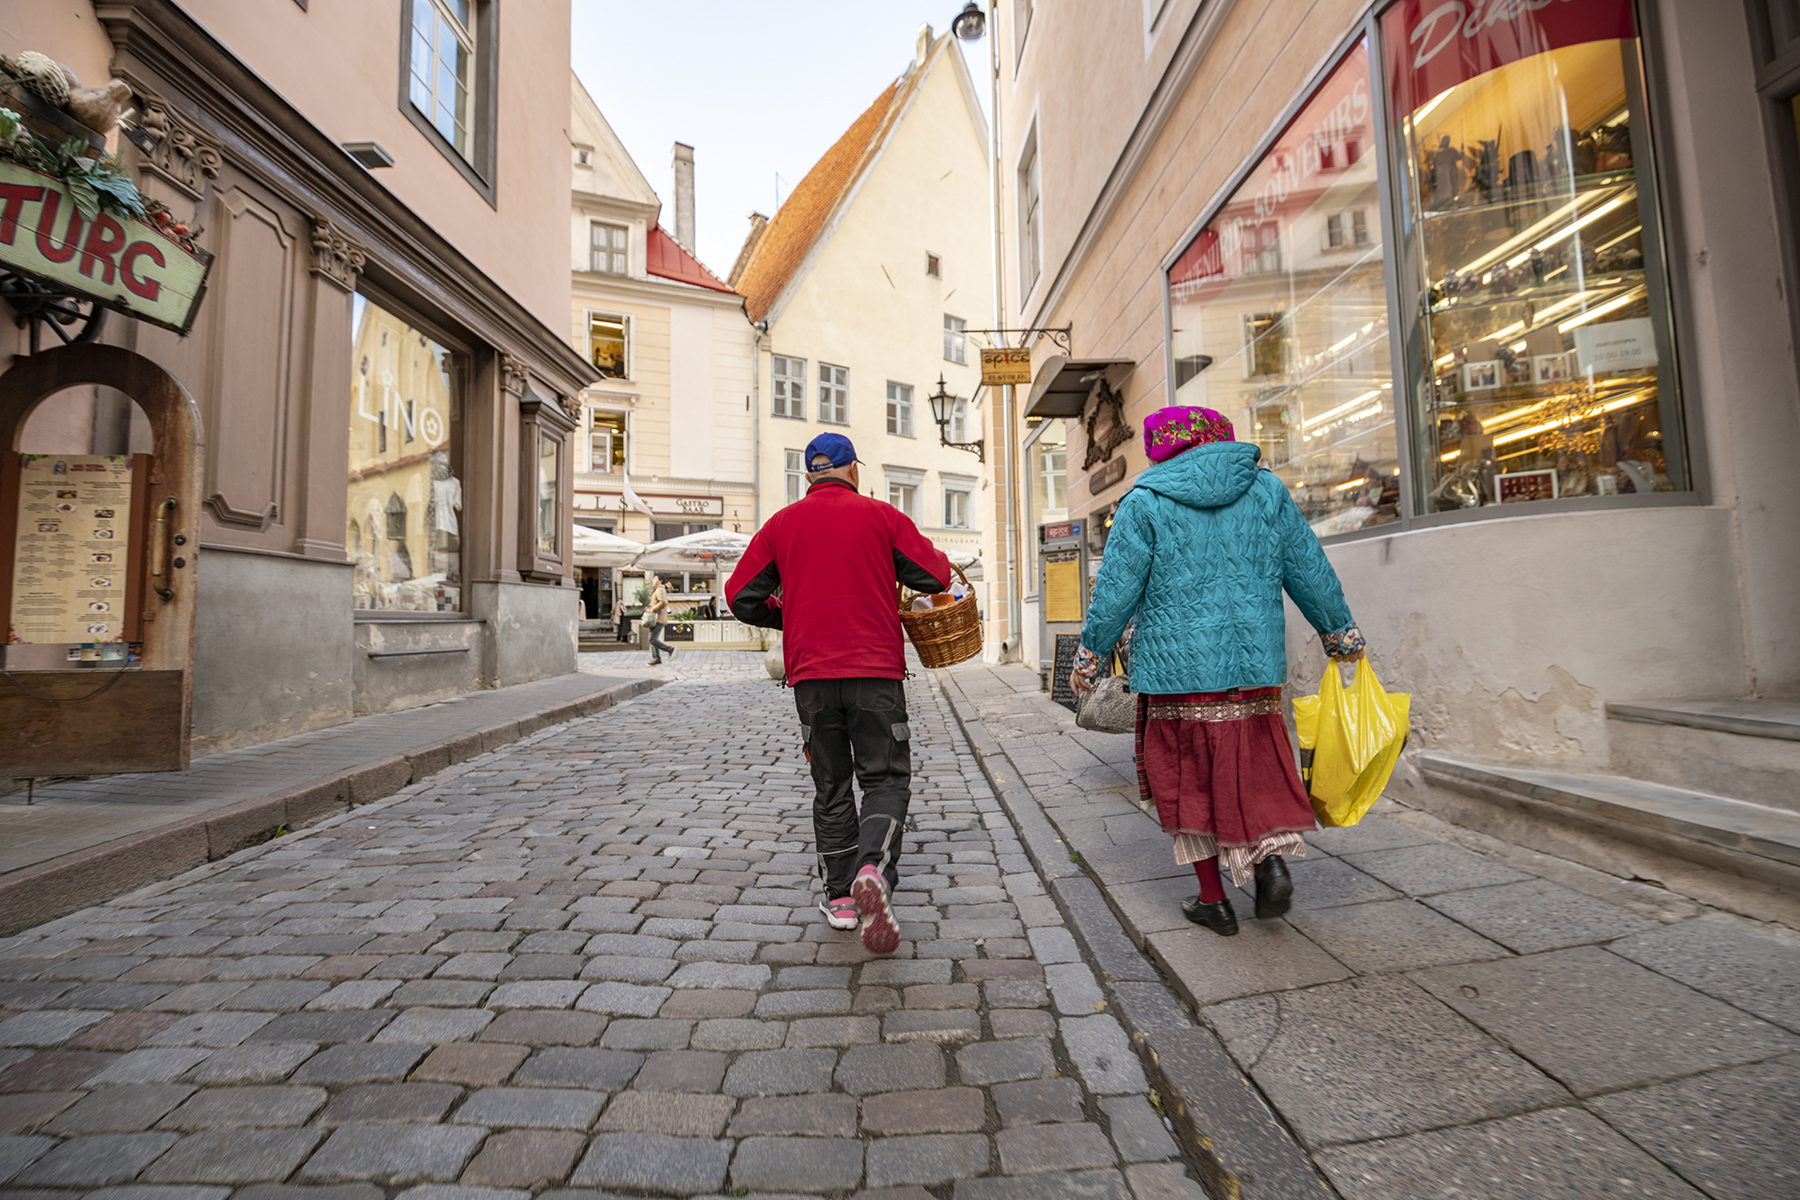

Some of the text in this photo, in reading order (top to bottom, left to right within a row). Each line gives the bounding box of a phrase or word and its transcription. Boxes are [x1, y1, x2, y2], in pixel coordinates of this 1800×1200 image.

[1254, 77, 1369, 227] SOUVENIRS
[0, 182, 167, 302] TURG
[358, 369, 444, 447] LINO
[683, 506, 705, 514] BAAR
[930, 536, 982, 545] NGIKAUBAMA
